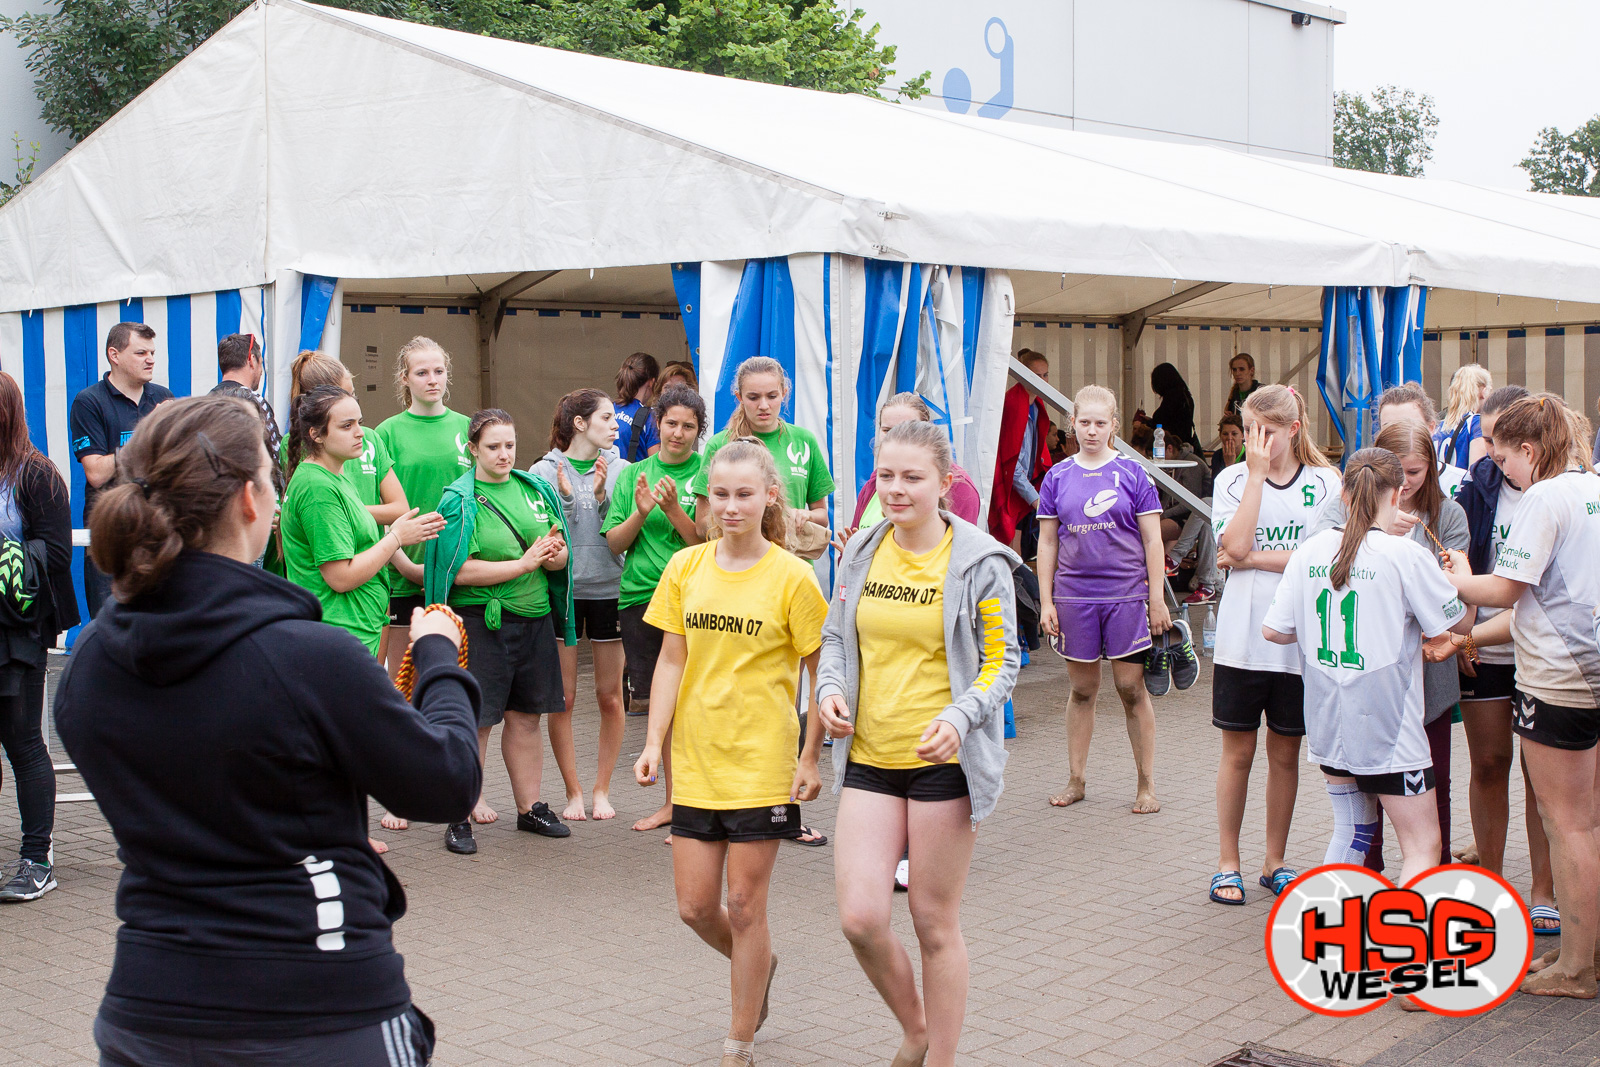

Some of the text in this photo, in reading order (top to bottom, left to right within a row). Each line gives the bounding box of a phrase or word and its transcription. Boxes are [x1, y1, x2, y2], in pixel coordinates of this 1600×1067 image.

[1111, 470, 1120, 488] 1
[1255, 519, 1304, 542] ewir
[1309, 565, 1328, 579] BKK
[1350, 566, 1377, 580] Aktiv
[862, 581, 920, 603] HAMBORN
[920, 587, 937, 605] 07
[685, 612, 763, 637] HAMBORN 07
[1315, 588, 1365, 671] 11
